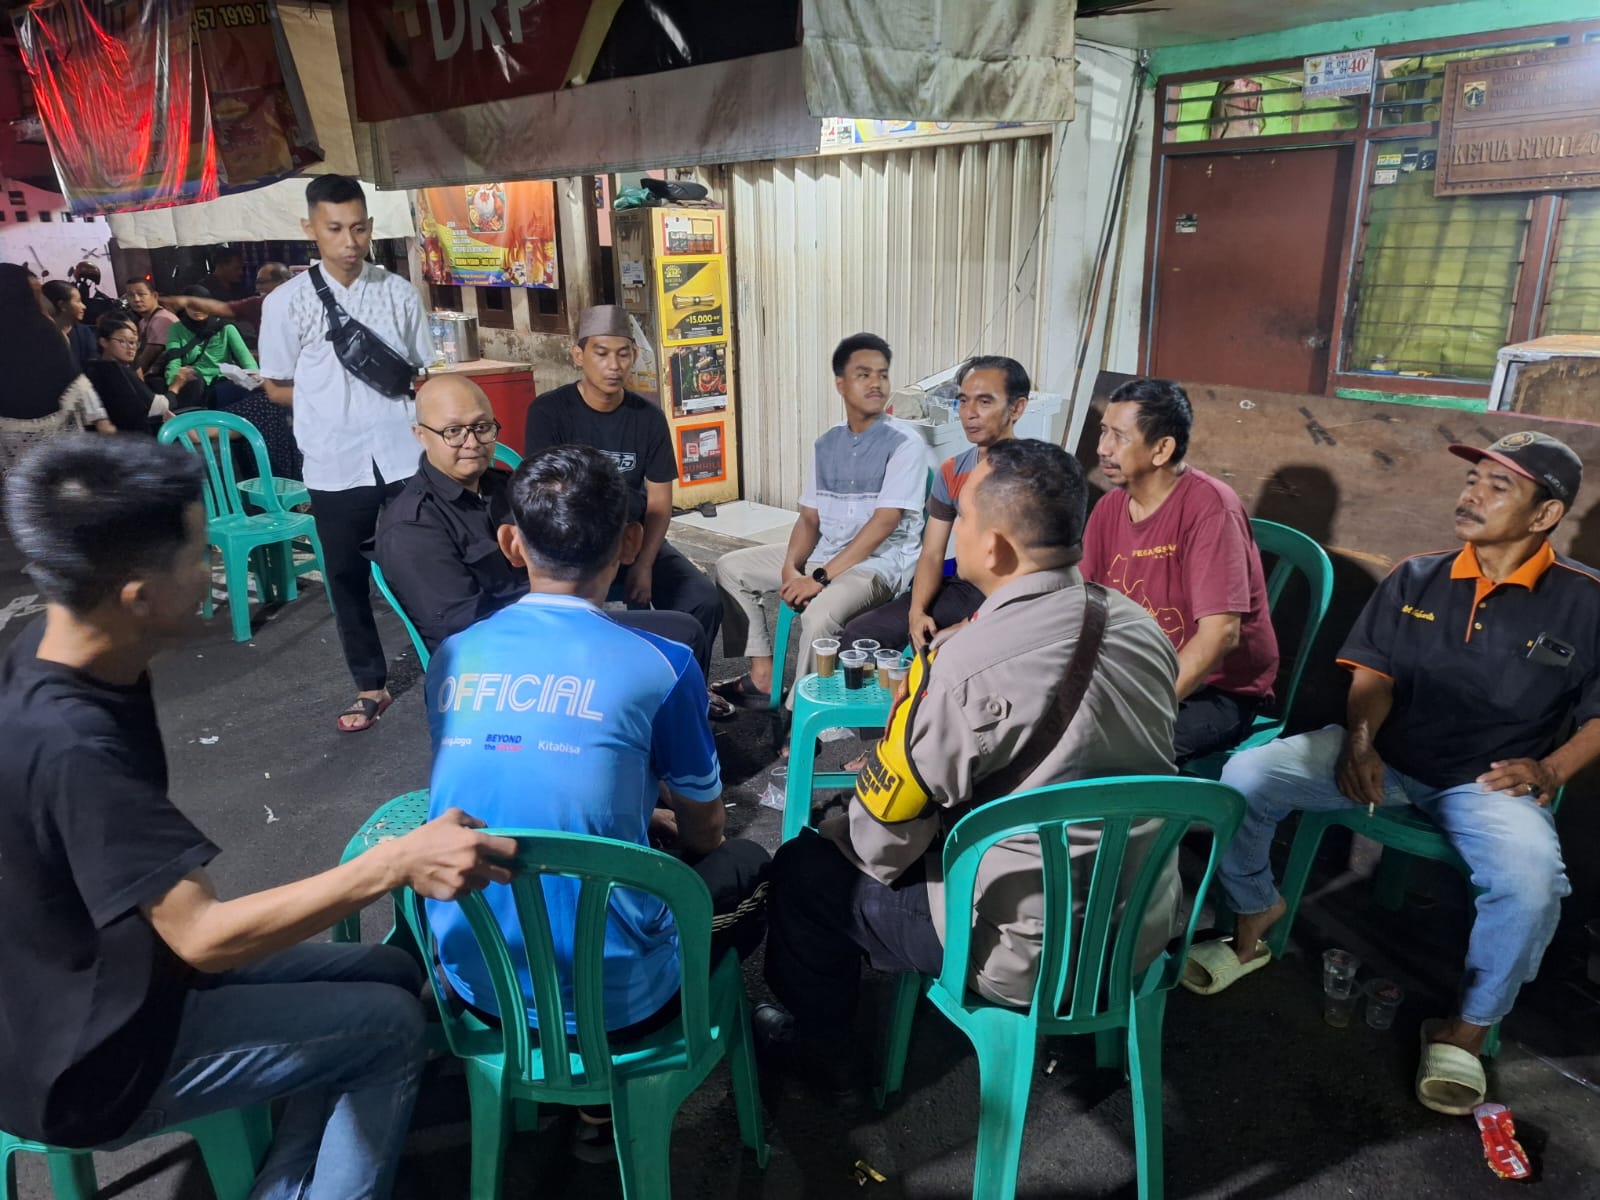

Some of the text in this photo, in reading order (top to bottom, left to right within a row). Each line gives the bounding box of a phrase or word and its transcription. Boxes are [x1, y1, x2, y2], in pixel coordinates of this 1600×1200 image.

[1452, 139, 1512, 166] KETUA
[437, 673, 604, 722] OFFICIAL
[485, 733, 523, 744] BEYOND
[537, 740, 581, 754] Kitabisa
